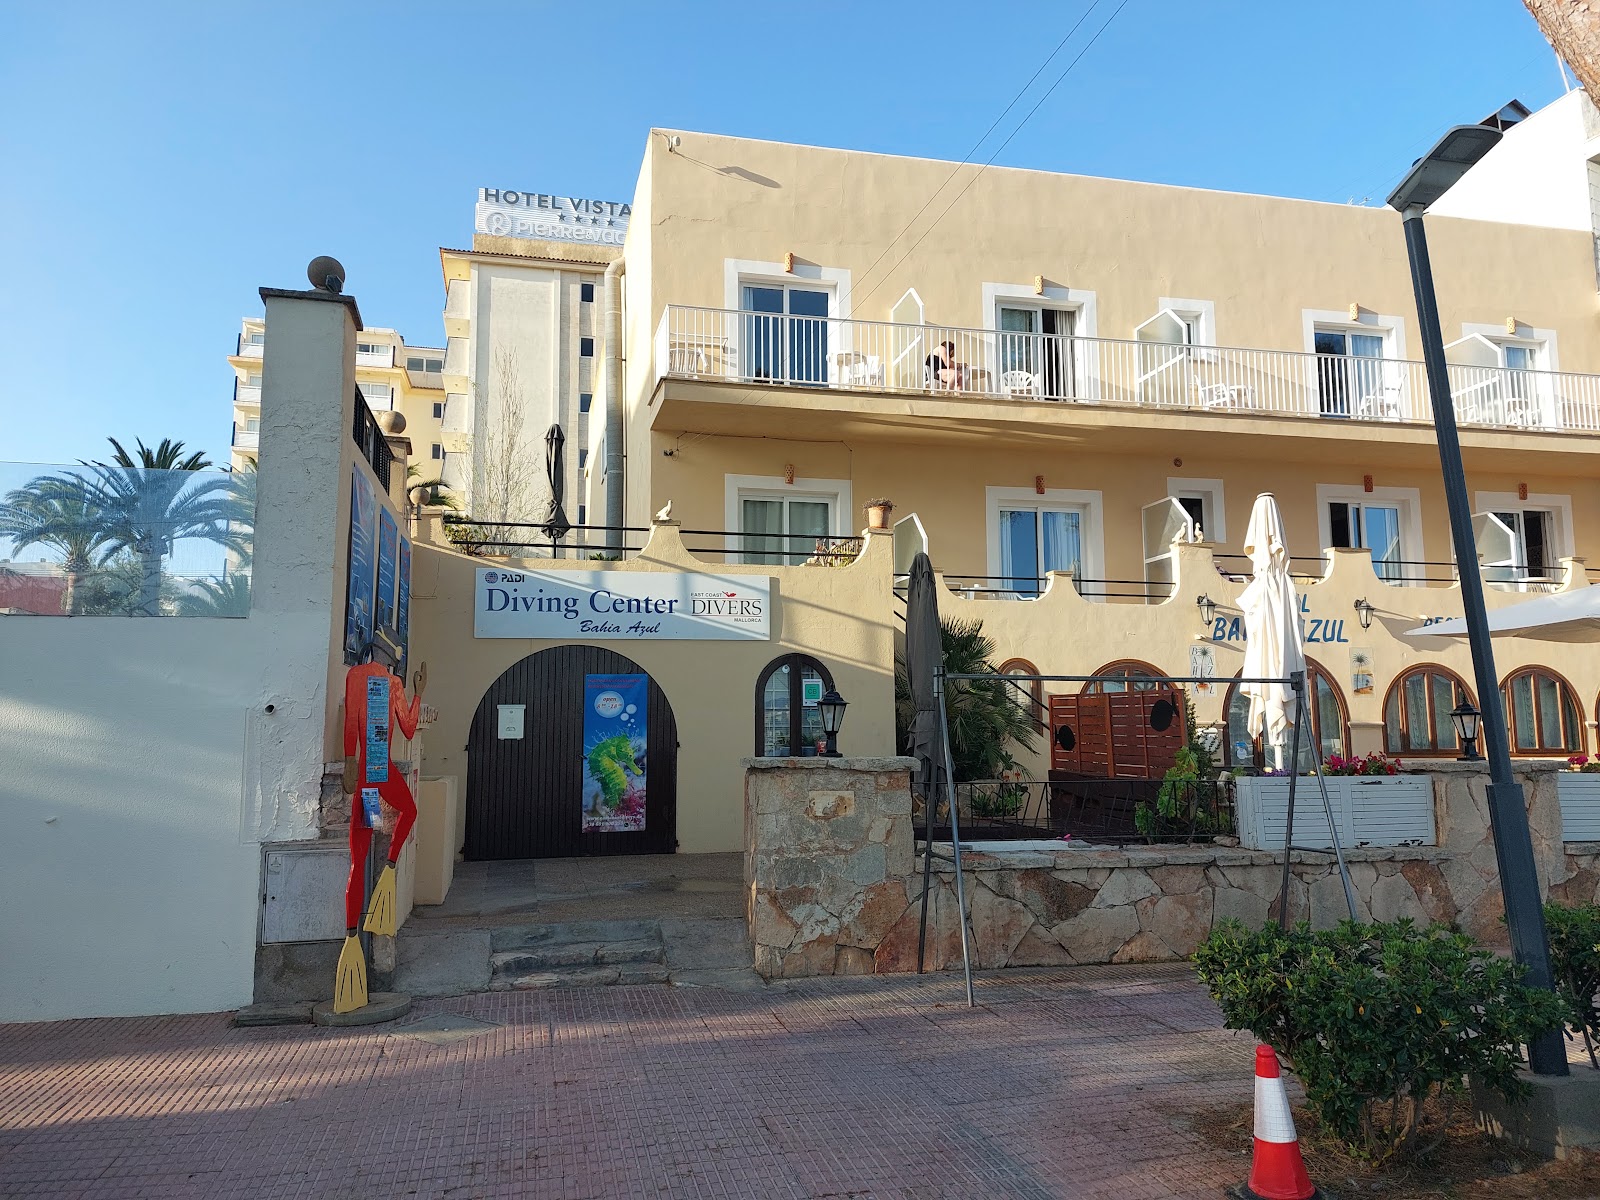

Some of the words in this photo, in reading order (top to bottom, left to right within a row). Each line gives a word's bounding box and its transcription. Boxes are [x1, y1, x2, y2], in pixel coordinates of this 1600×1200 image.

[484, 187, 563, 210] HOTEL
[501, 573, 525, 583] PADI
[485, 588, 579, 619] Diving
[589, 590, 679, 614] Center
[691, 599, 762, 616] DIVERS
[579, 619, 622, 633] Bahia
[626, 621, 661, 637] Azul
